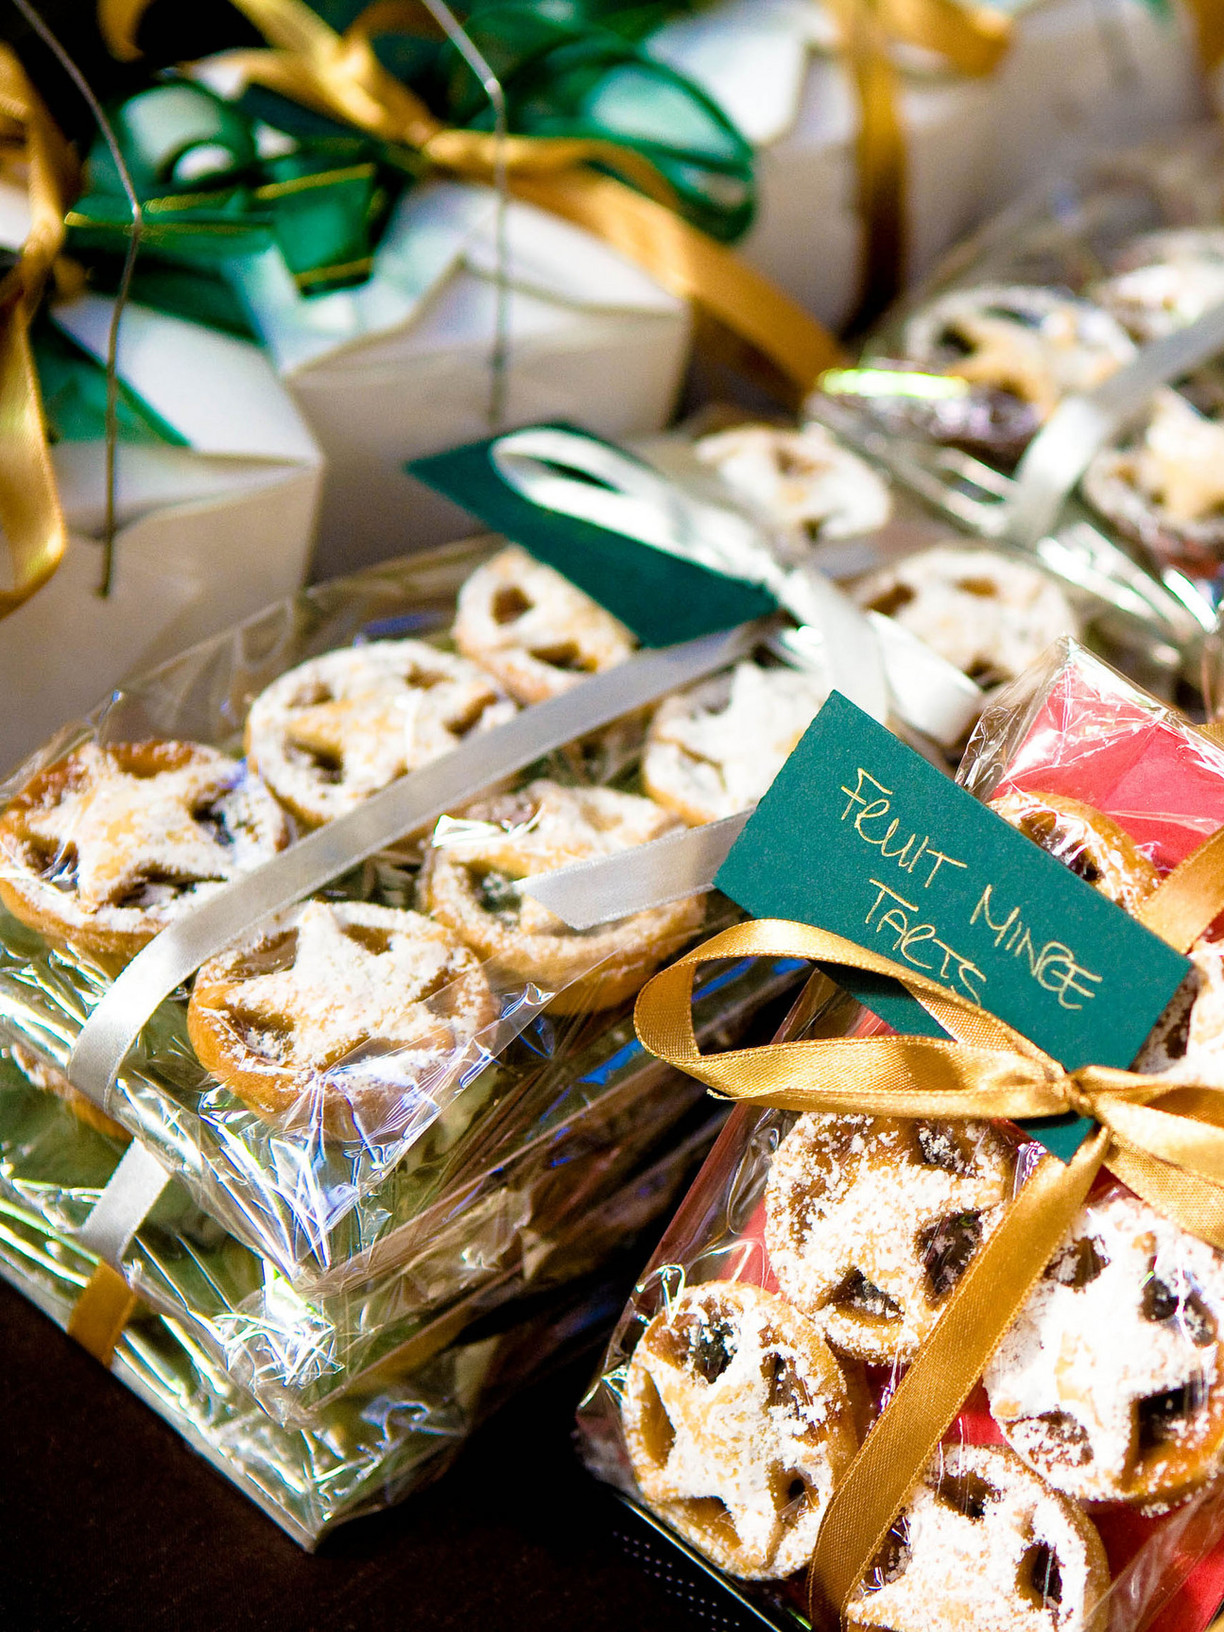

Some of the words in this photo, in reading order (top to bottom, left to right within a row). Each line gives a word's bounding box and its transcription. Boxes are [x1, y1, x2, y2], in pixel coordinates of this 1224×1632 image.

[840, 767, 968, 888] FRUIT
[969, 884, 1103, 1010] MINCE
[864, 878, 987, 1008] TARTS
